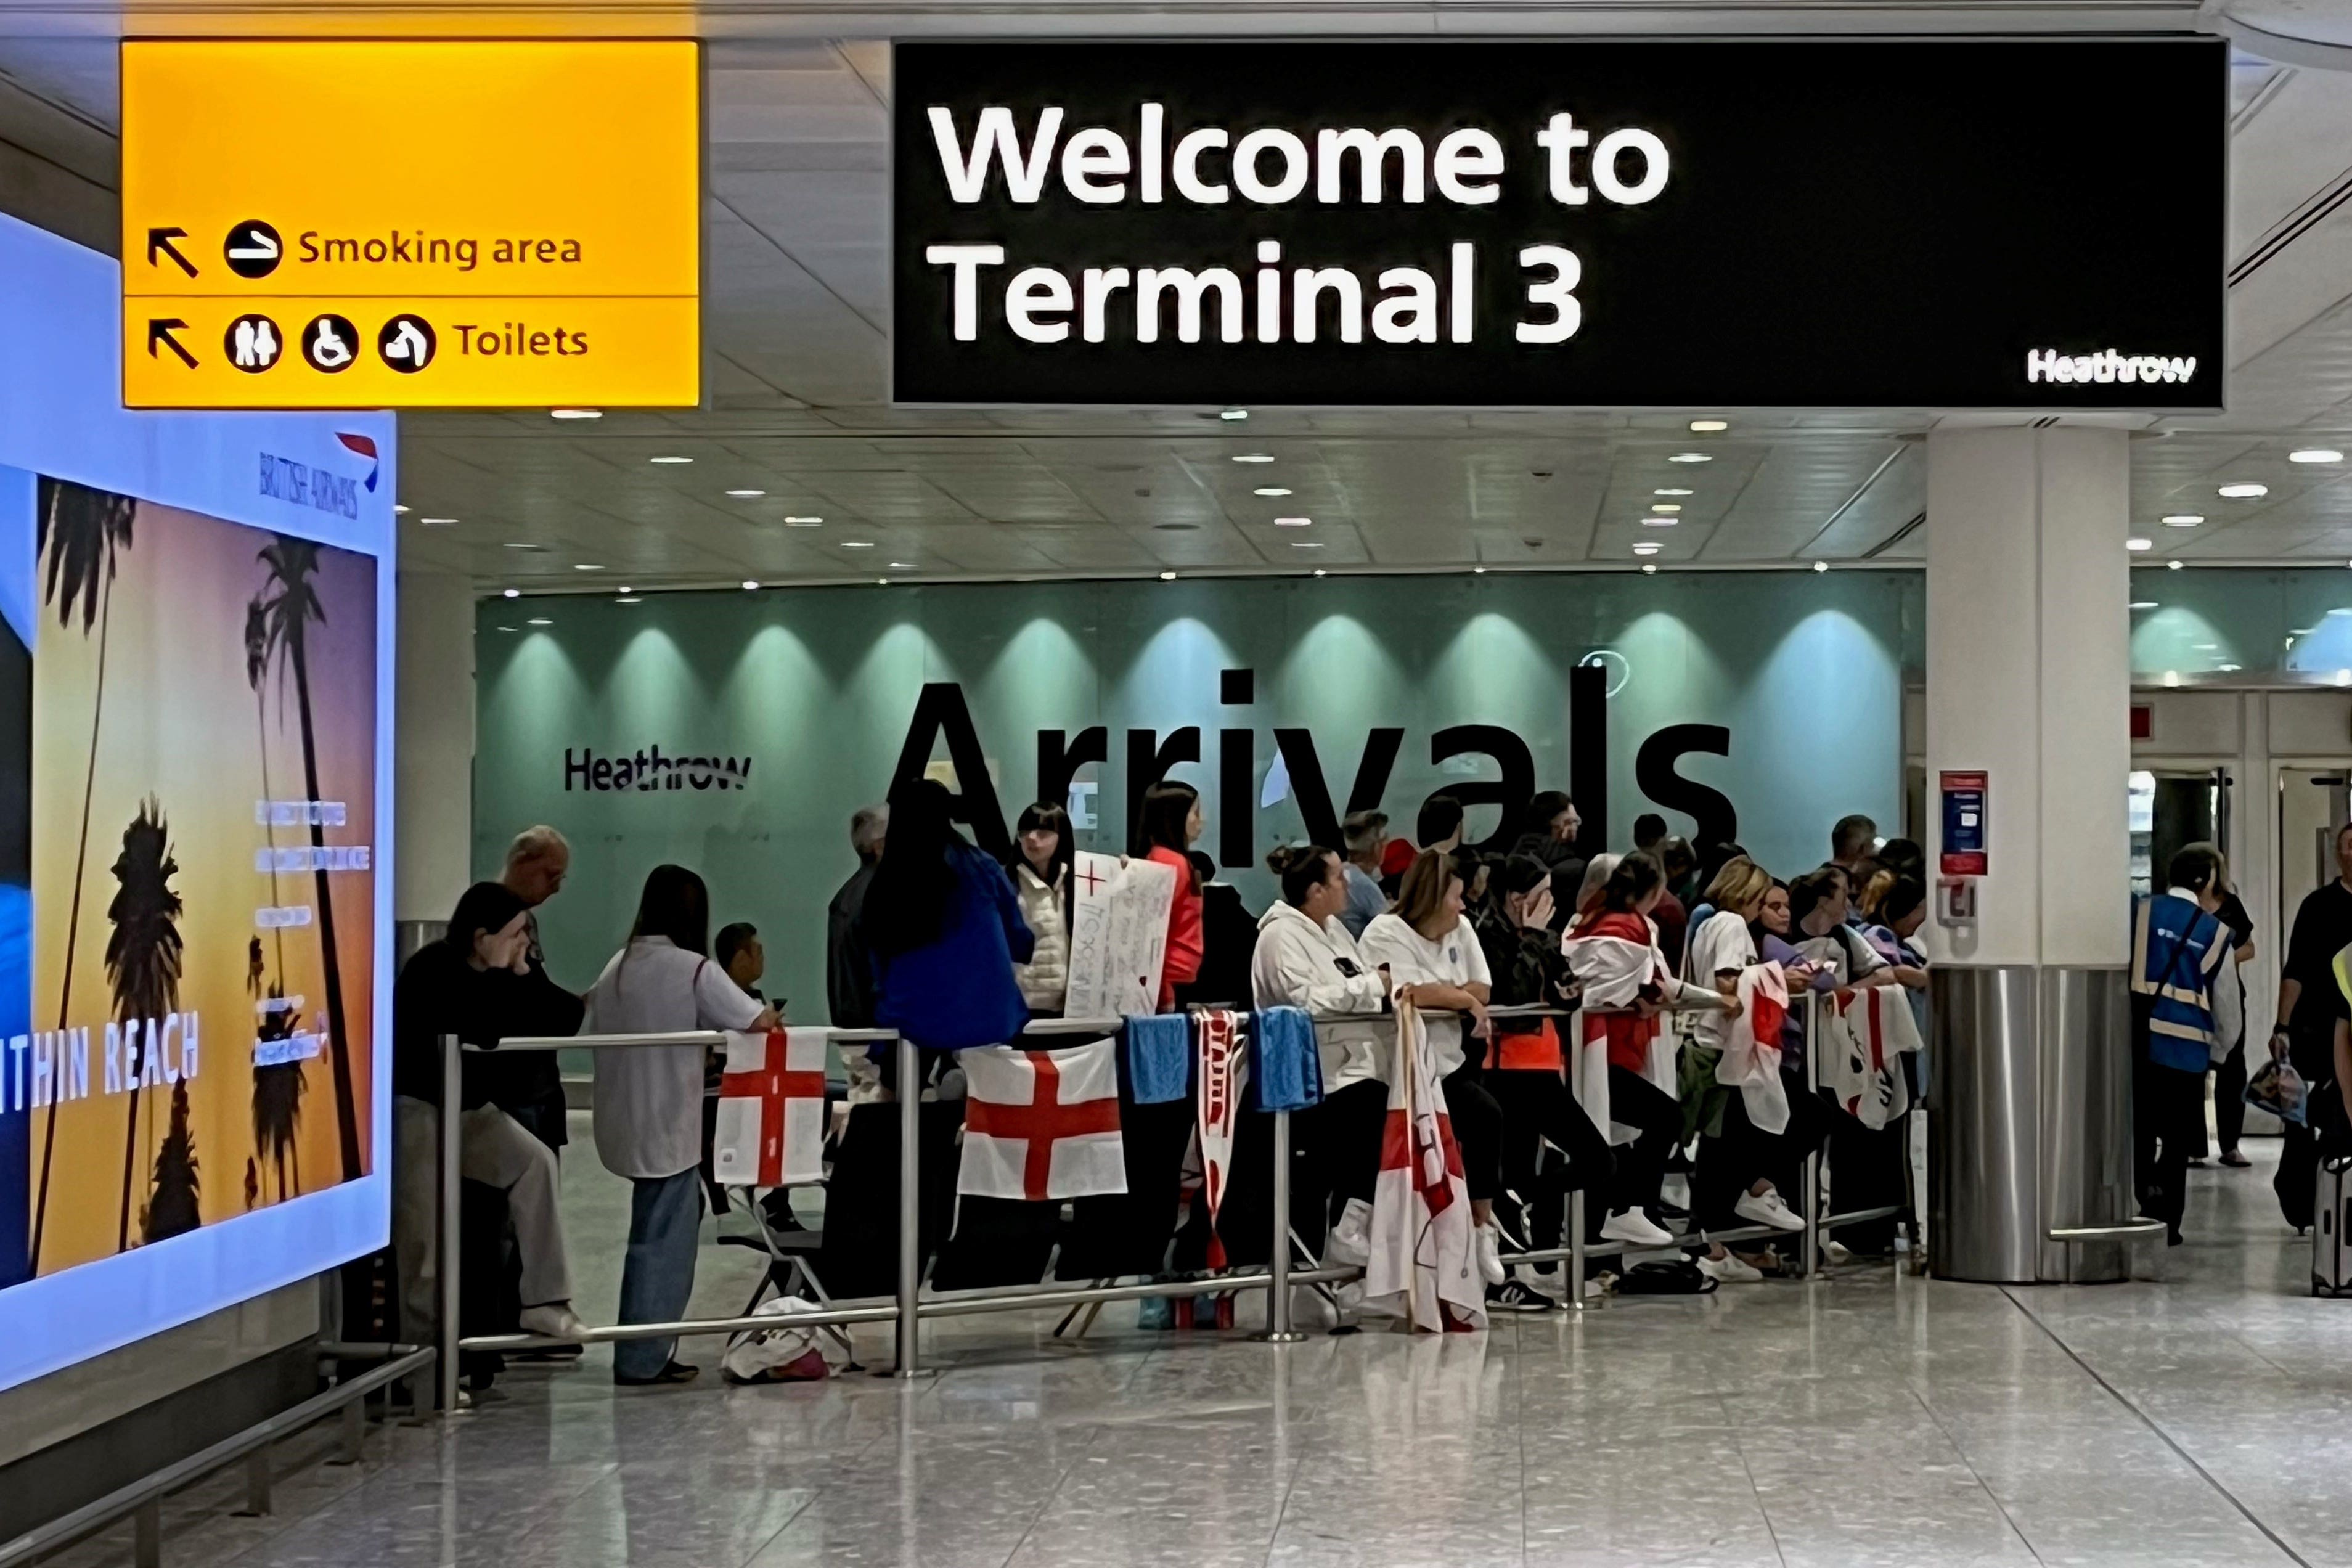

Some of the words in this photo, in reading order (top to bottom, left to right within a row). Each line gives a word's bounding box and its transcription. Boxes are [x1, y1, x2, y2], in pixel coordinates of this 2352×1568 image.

[927, 102, 1505, 205] Welcome
[1537, 112, 1670, 205] to
[299, 230, 478, 272] Smoking
[492, 238, 581, 263] area
[926, 240, 1474, 343] Terminal
[1515, 245, 1582, 344] 3
[452, 322, 588, 356] Toilets
[2028, 348, 2197, 383] Heathrow
[565, 744, 751, 791] Heathrow
[888, 666, 1739, 868] Arrivals
[104, 1010, 199, 1095] REACH
